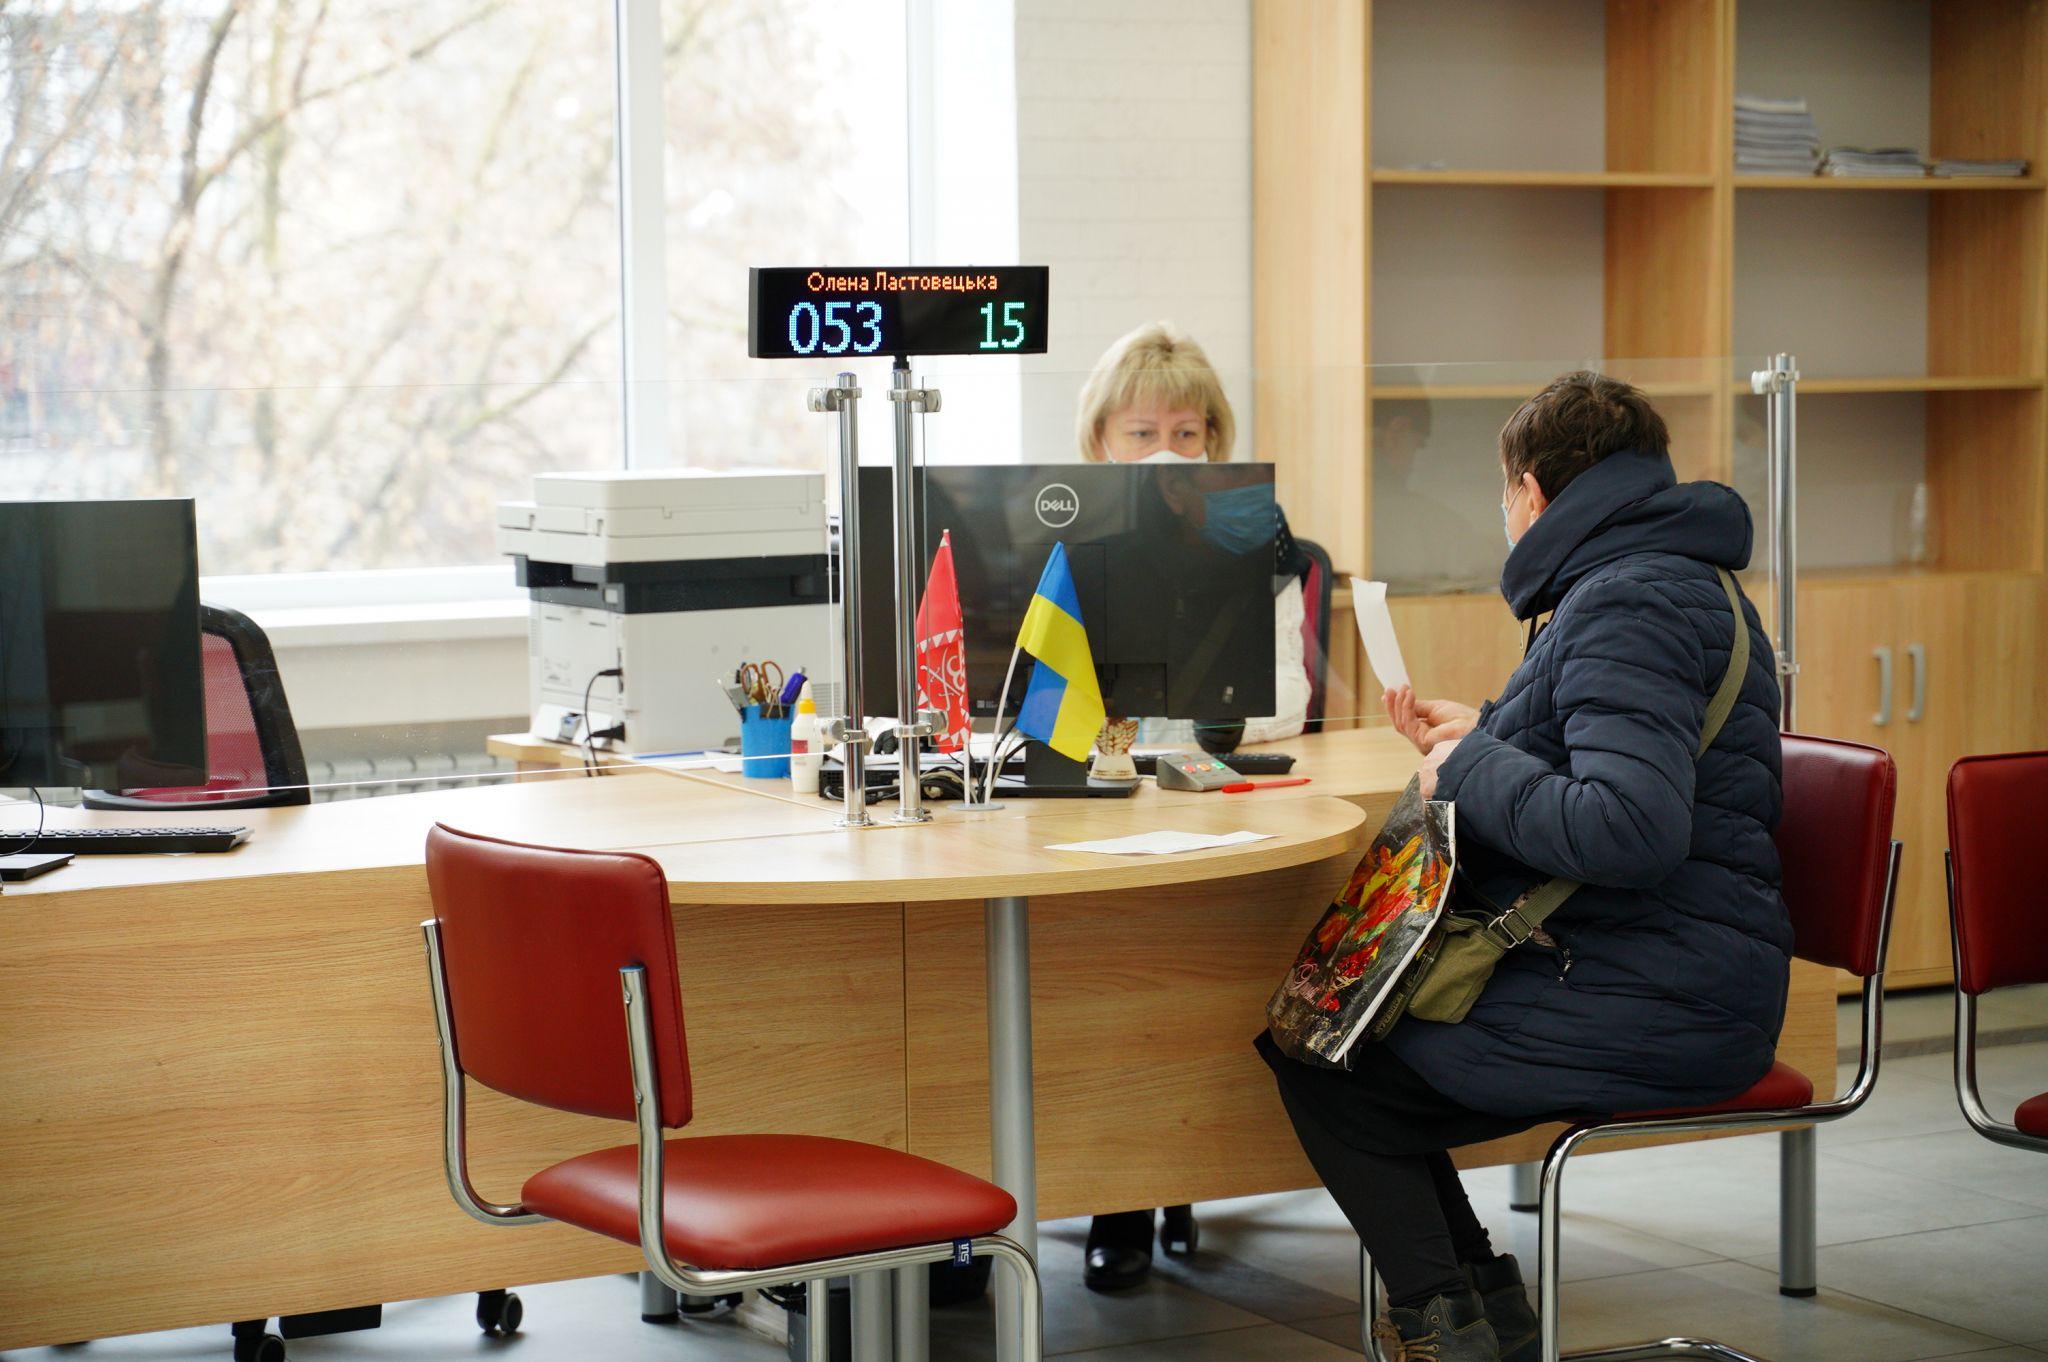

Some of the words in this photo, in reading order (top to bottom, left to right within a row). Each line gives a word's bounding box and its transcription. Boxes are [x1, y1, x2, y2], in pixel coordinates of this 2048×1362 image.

[807, 271, 869, 291] Олена
[874, 271, 998, 293] Ластовецька
[788, 301, 882, 354] 053
[979, 301, 1025, 349] 15
[1041, 499, 1075, 512] DELL
